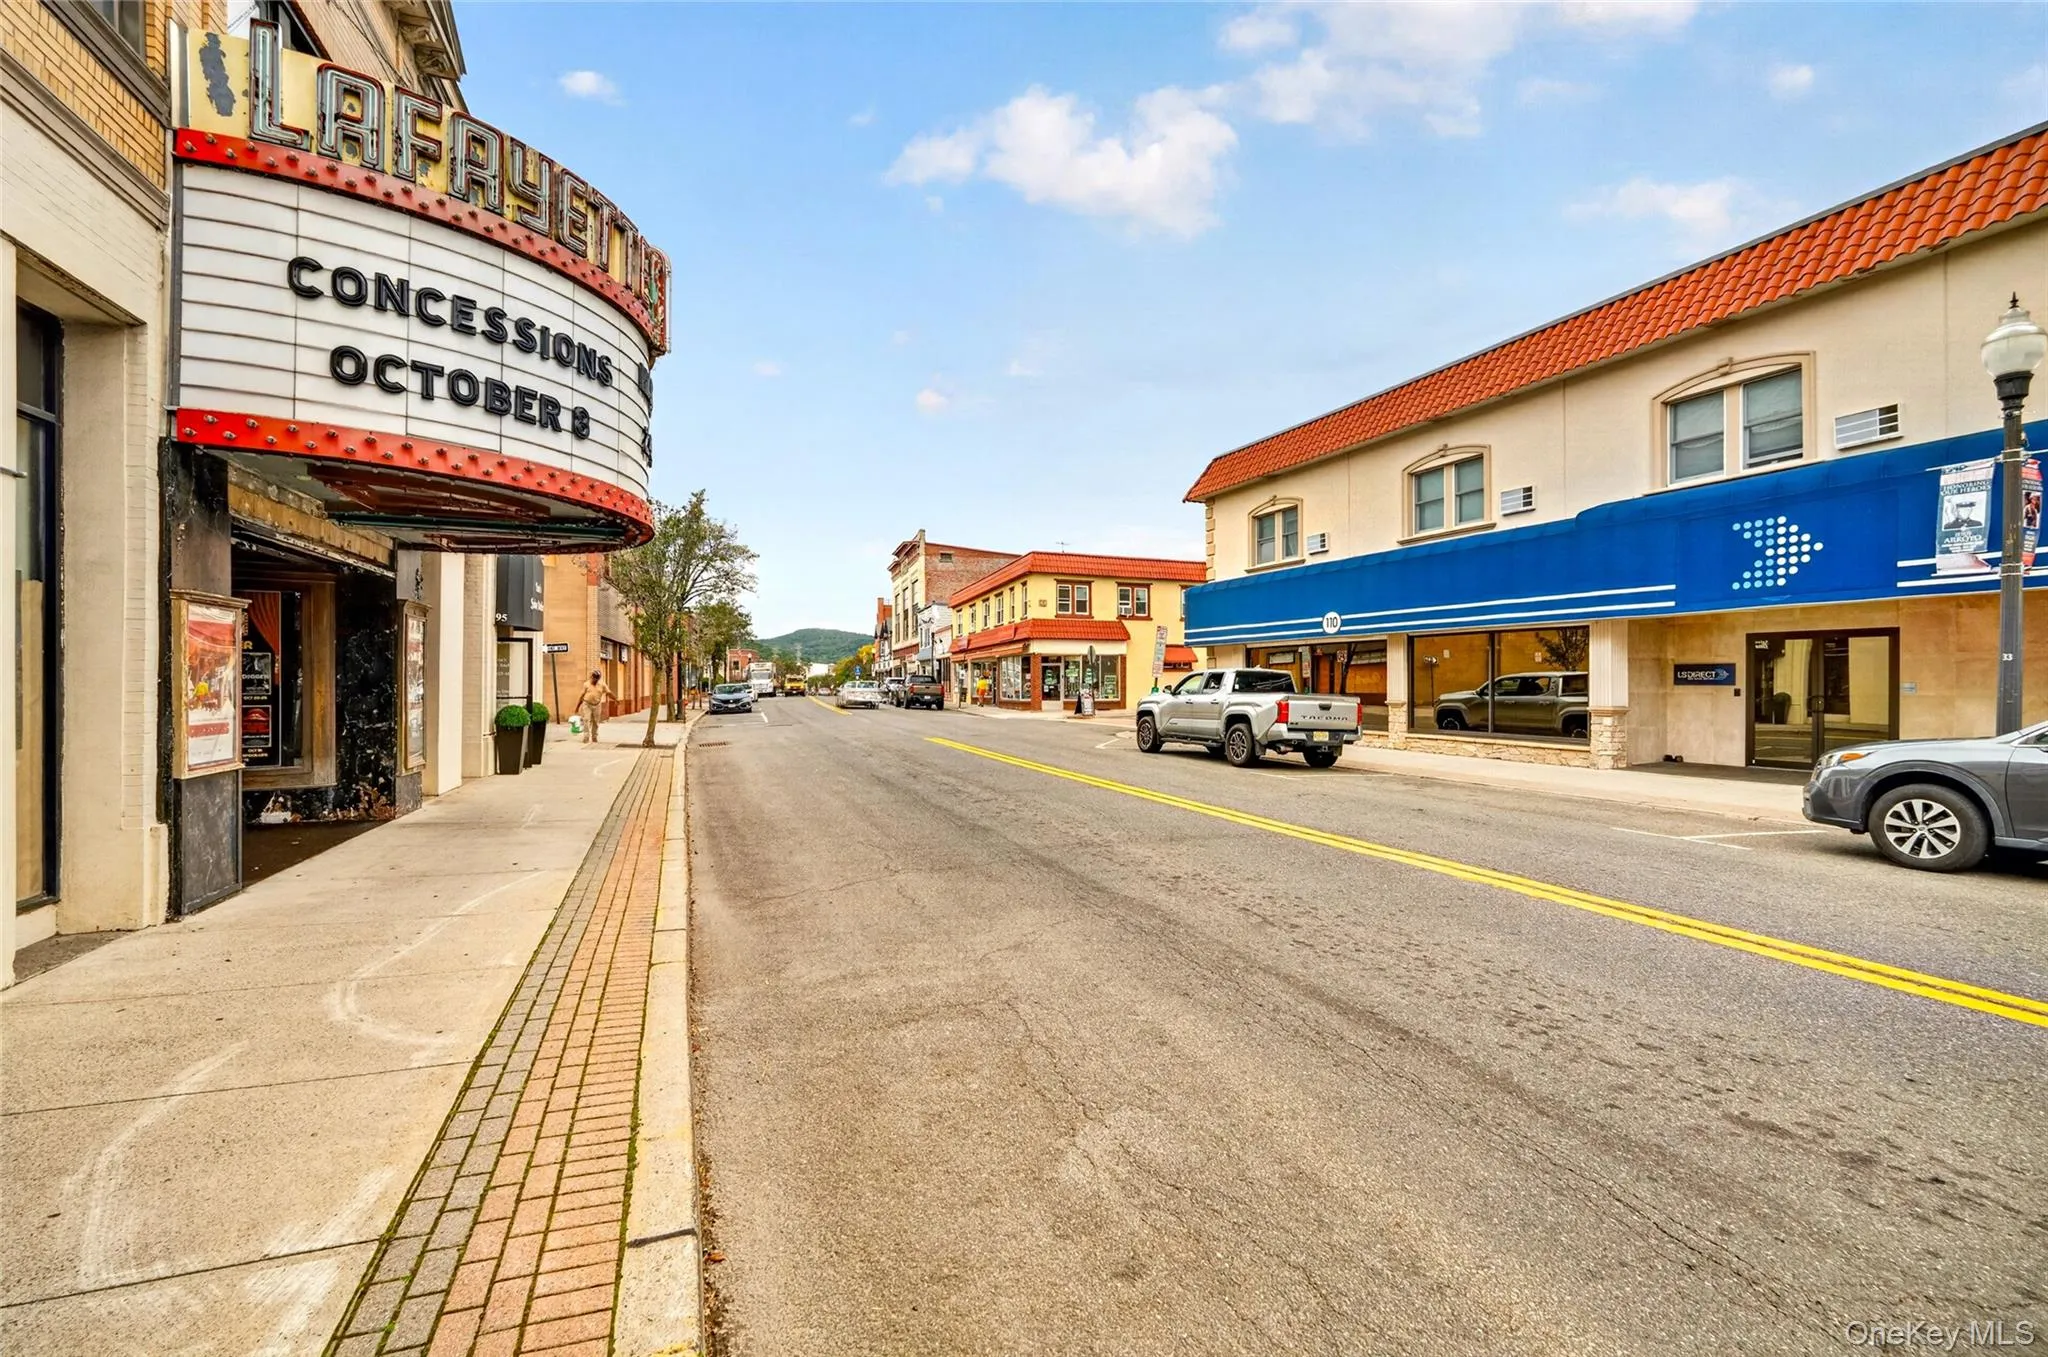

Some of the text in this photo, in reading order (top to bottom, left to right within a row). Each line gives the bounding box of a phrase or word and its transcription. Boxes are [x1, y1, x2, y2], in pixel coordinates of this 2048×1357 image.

[287, 256, 613, 387] CONCESSIONS
[330, 345, 562, 433] OCTOBER
[496, 613, 508, 622] 95
[1325, 616, 1339, 628] 110
